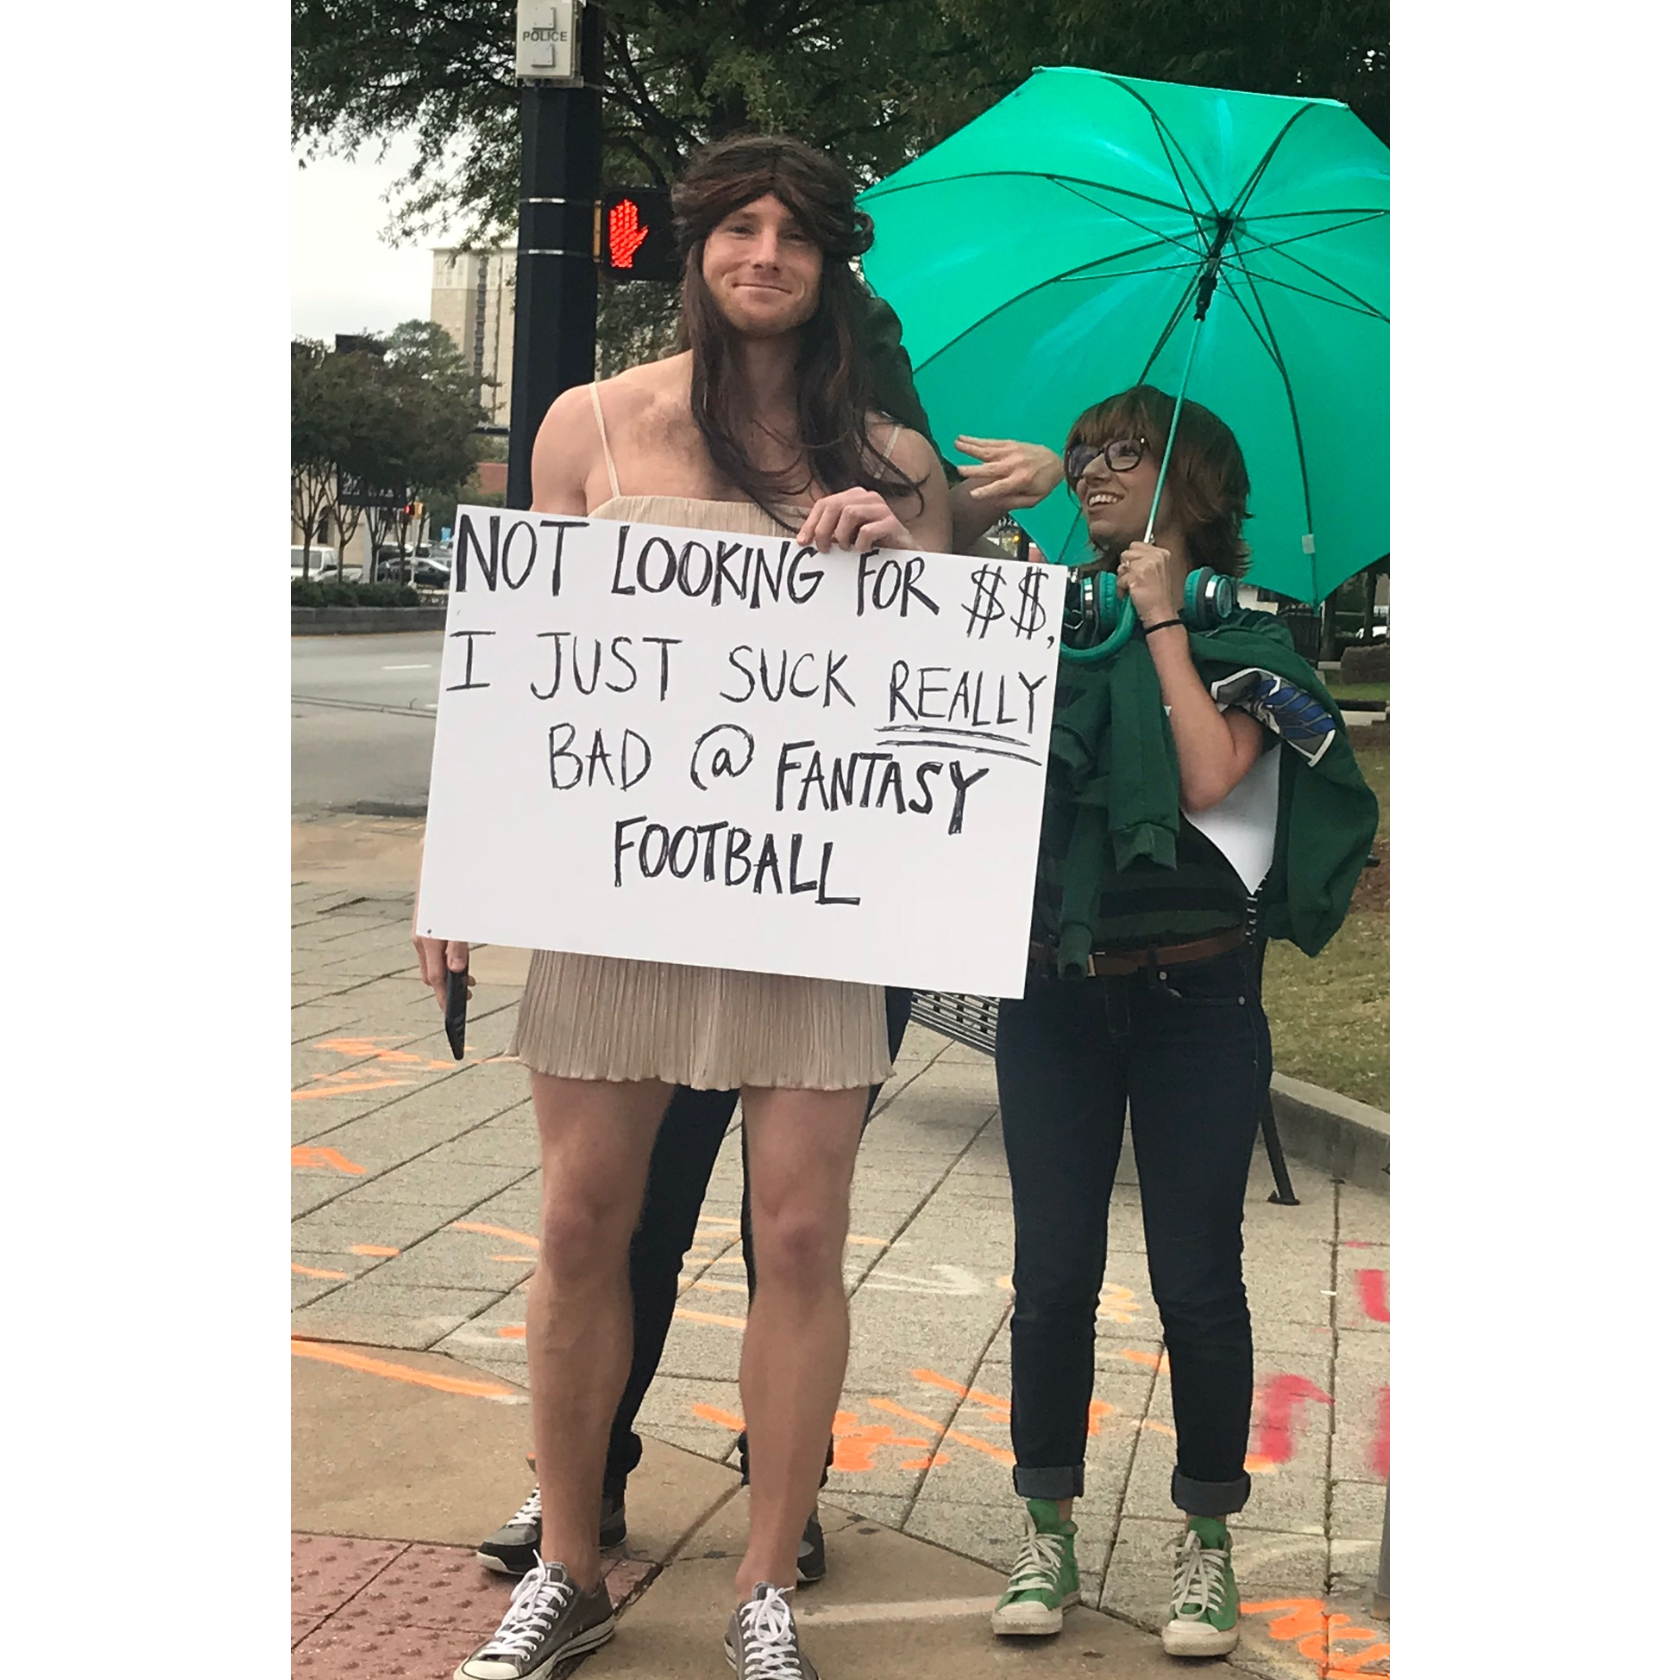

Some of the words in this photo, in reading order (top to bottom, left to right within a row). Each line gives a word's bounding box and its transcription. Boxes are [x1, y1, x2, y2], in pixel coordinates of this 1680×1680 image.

[522, 31, 568, 42] POLICE
[455, 513, 590, 597] NOT
[611, 524, 825, 609] LOOKING
[857, 549, 939, 617] FOR
[961, 563, 1055, 649] $$,
[446, 630, 496, 691] I
[530, 631, 683, 702] JUST
[719, 645, 856, 709] SUCK
[888, 659, 1048, 734] REALLY
[549, 722, 651, 791] BAD
[690, 723, 754, 791] @
[775, 740, 990, 835] FANTASY
[613, 815, 861, 905] FOOTBALL
